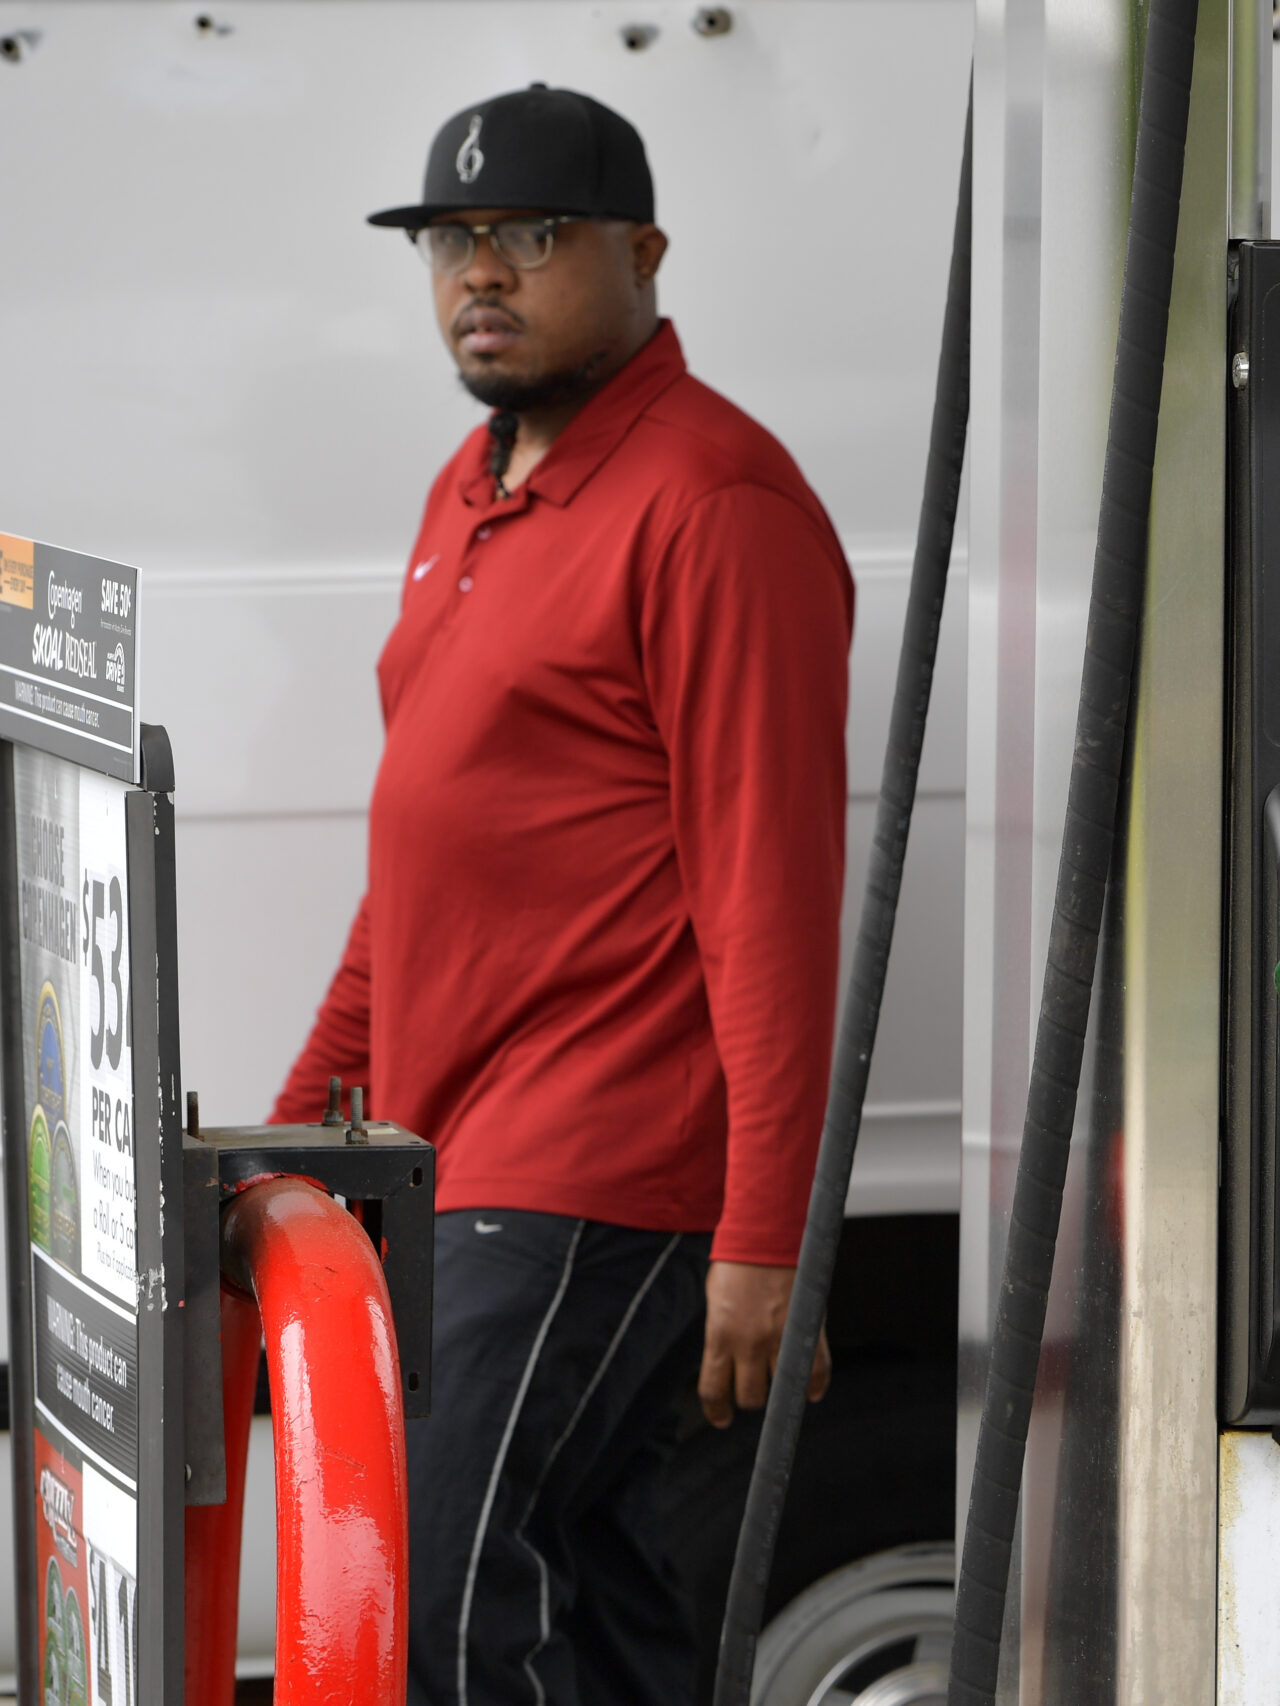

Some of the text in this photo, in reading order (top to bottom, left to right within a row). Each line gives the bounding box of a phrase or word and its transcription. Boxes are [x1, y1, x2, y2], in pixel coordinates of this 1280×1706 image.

[48, 570, 83, 629] Copenhagen
[101, 578, 119, 615] SAVE
[32, 623, 63, 671] SKOAL
[92, 1086, 112, 1147] PER
[75, 1318, 88, 1361] This
[88, 1336, 114, 1379] product
[114, 1356, 127, 1388] can
[57, 1364, 115, 1433] cause mouth cancer.
